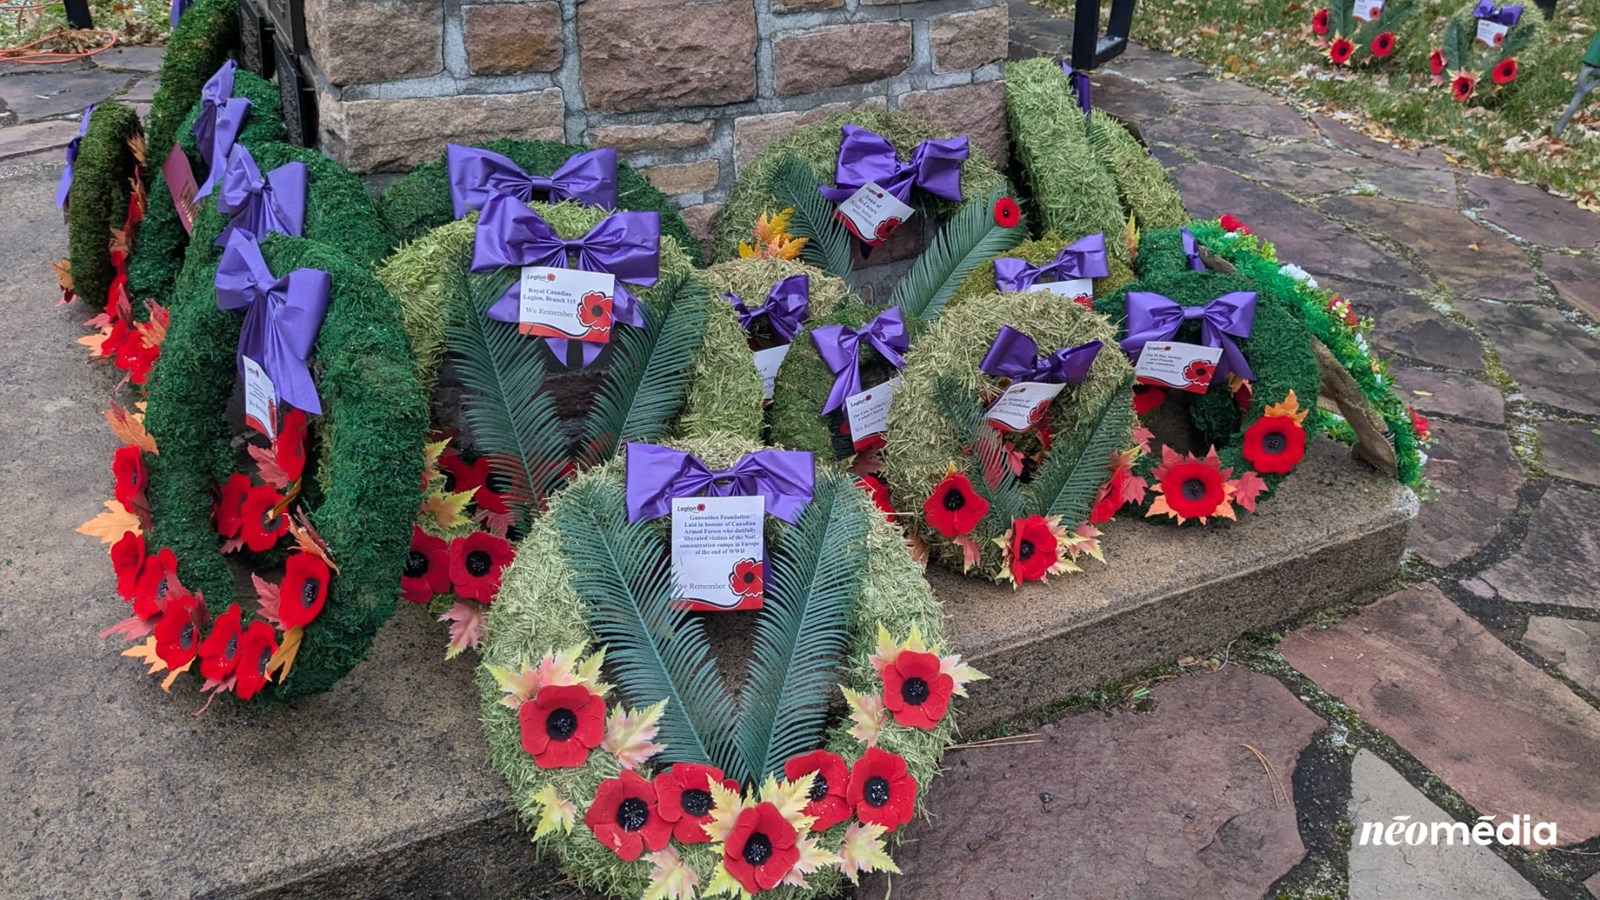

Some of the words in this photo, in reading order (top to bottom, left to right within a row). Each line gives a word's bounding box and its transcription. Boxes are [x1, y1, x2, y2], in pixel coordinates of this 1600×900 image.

[527, 273, 547, 281] Legion
[546, 289, 572, 297] Canadian
[523, 294, 545, 302] Legion,
[539, 307, 574, 318] Remember
[1150, 367, 1179, 375] Remember
[850, 399, 866, 408] Legion
[689, 582, 726, 590] Remember
